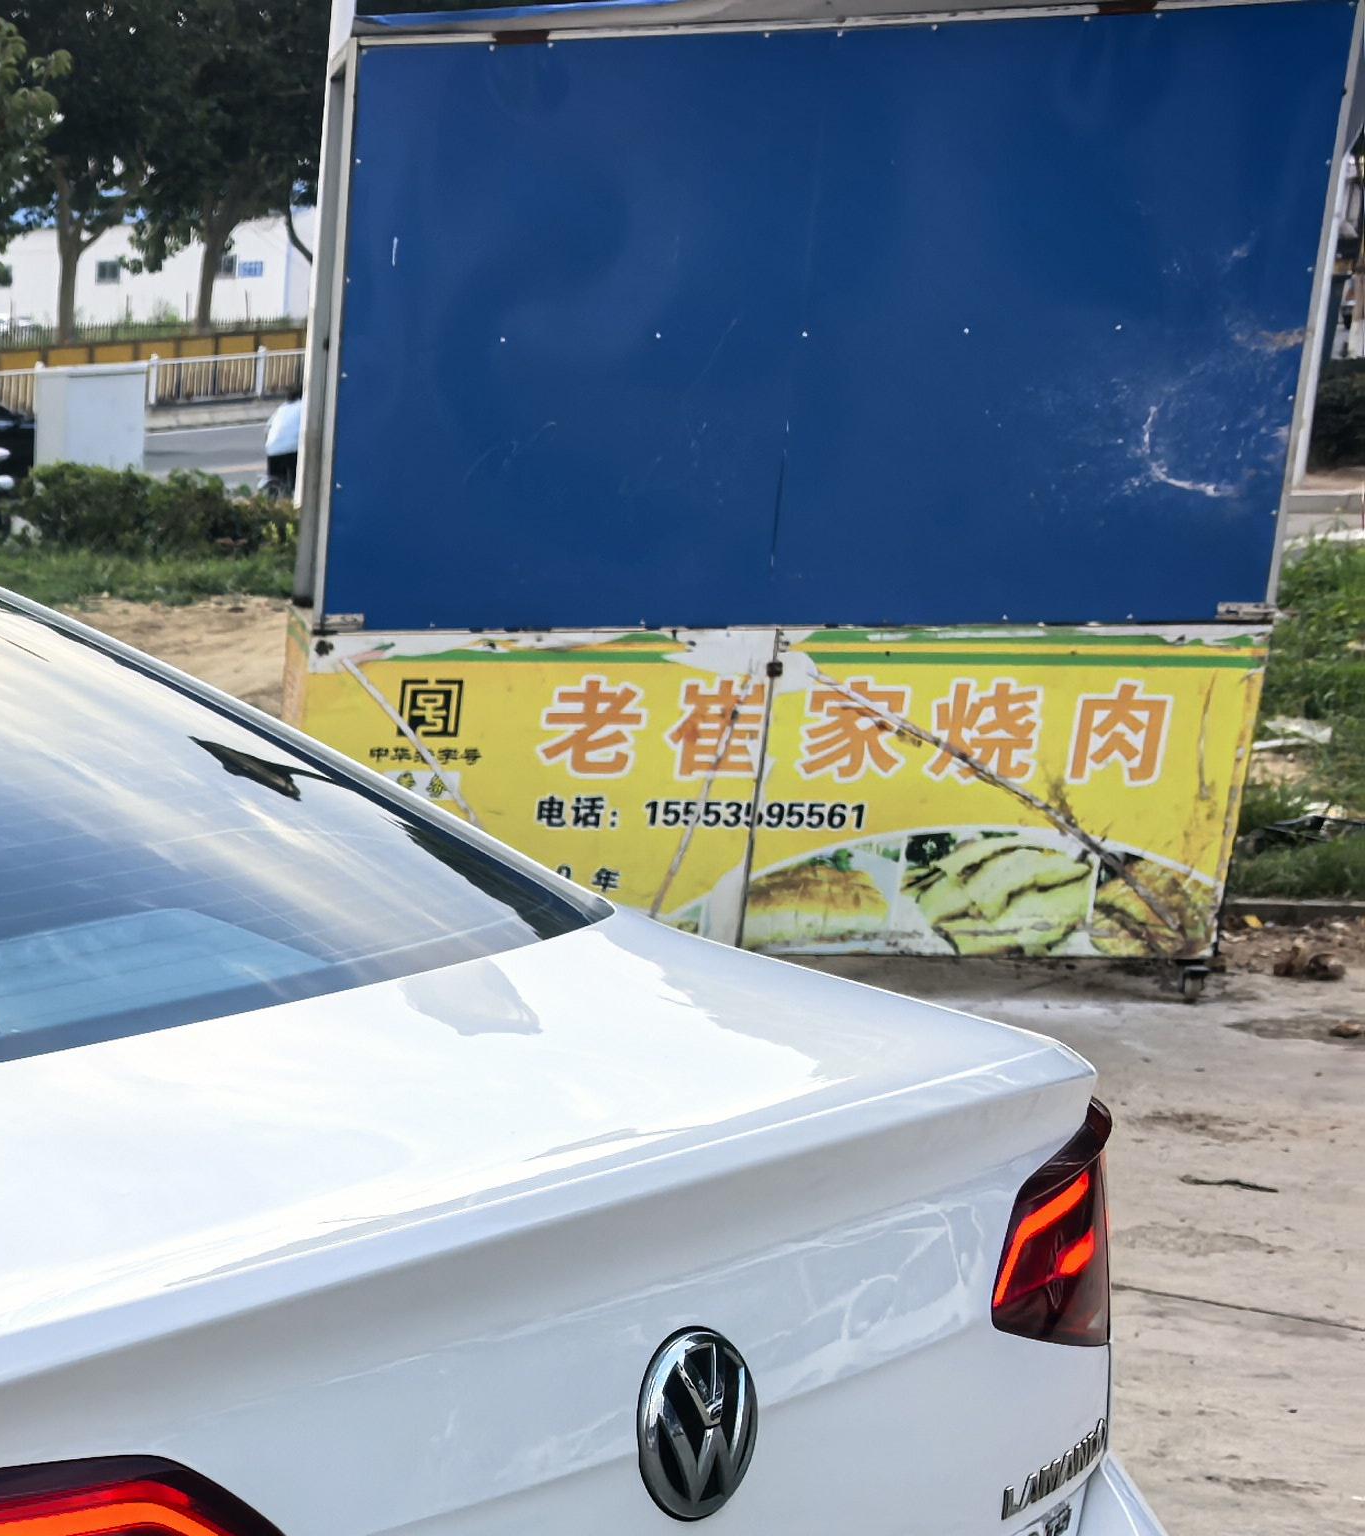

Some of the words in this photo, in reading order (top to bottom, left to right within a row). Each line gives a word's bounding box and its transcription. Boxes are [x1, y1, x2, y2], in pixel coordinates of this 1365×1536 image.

[540, 679, 1169, 782] 老崔家烧肉
